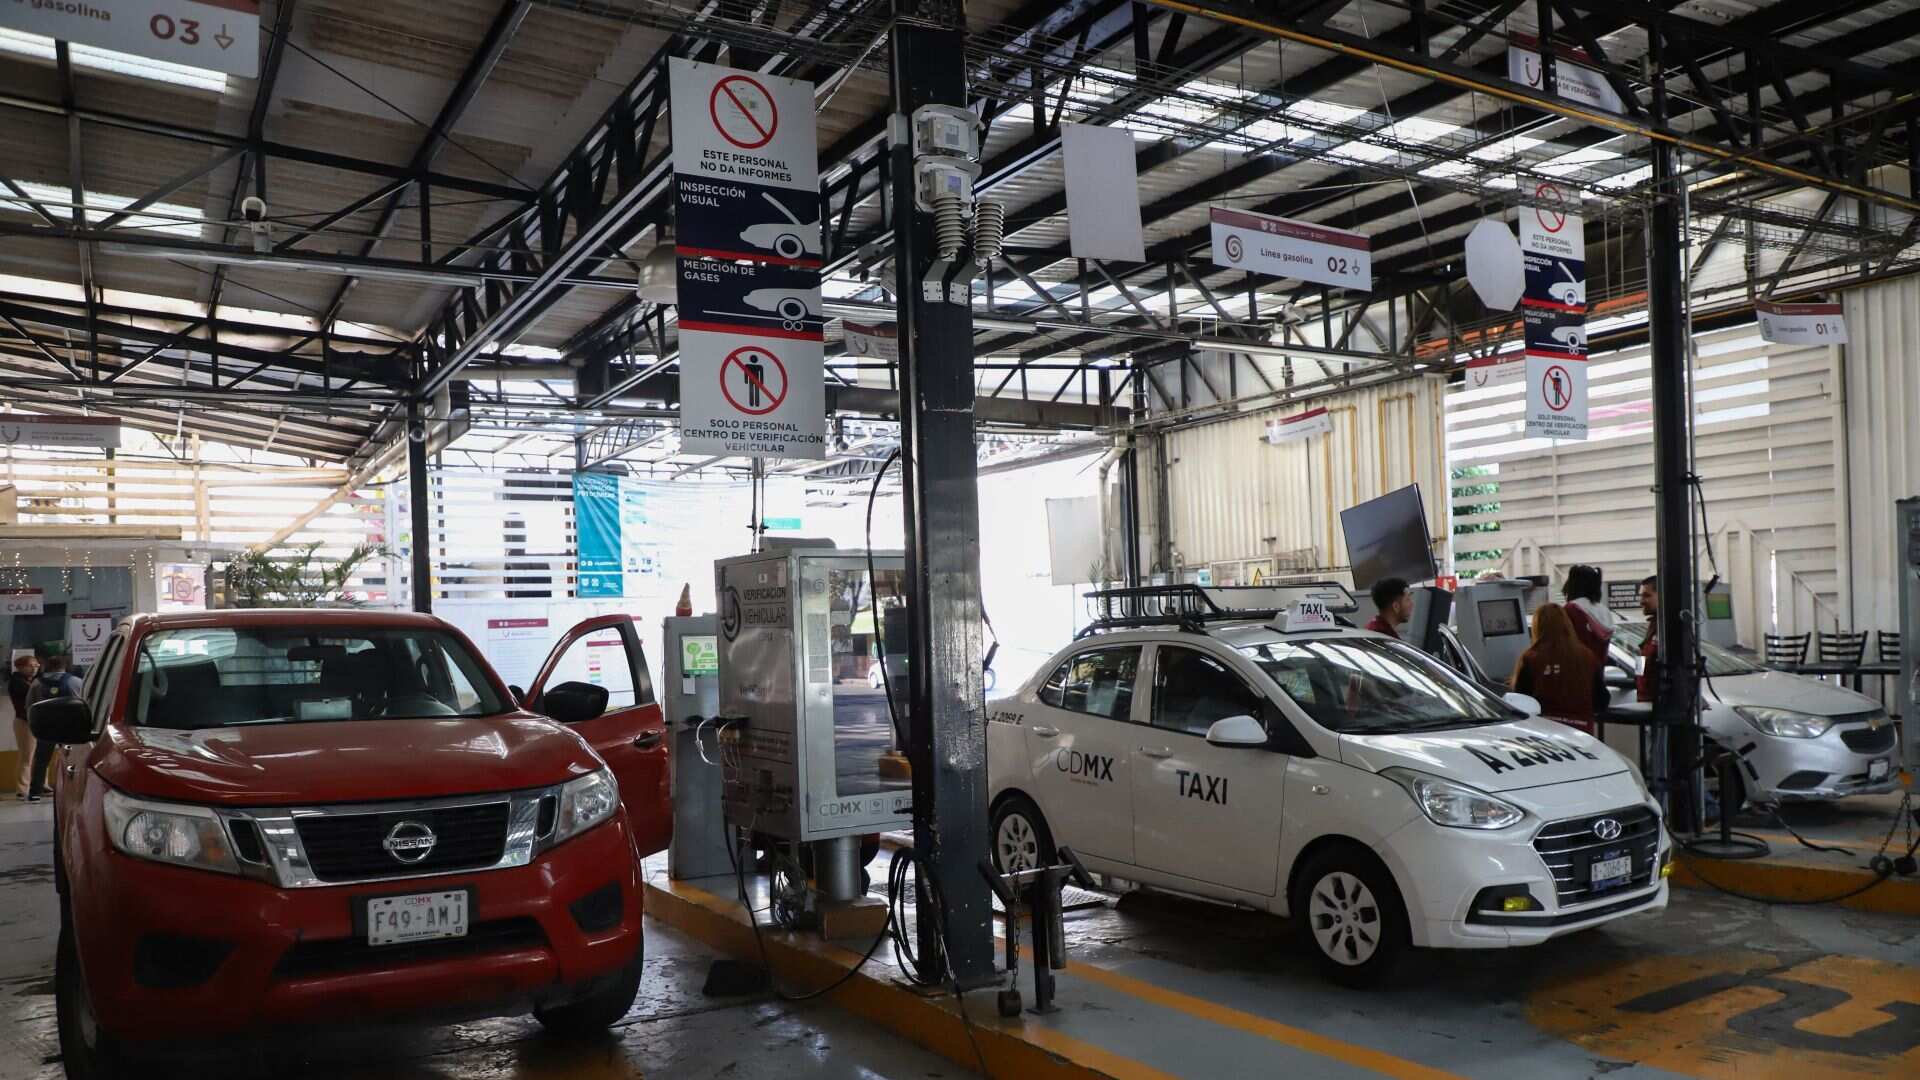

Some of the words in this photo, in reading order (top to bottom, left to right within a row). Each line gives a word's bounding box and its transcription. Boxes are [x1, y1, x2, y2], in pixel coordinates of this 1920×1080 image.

[150, 13, 200, 45] 03
[703, 149, 729, 162] ESTE
[732, 153, 789, 171] PERSONAL
[700, 160, 717, 172] NO
[719, 163, 735, 174] DA
[738, 165, 793, 182] INFORMES
[680, 180, 746, 199] INSPECCIÓN
[680, 193, 721, 208] VISUAL
[1545, 236, 1572, 247] PERSONAL
[683, 259, 738, 275] MEDICIÓN
[740, 266, 756, 276] DE
[1282, 252, 1314, 264] gasolina
[1327, 256, 1348, 275] 02
[684, 271, 720, 283] GASES
[1815, 323, 1829, 335] 01
[710, 419, 739, 429] SOLO
[742, 420, 799, 432] PERSONAL
[1551, 414, 1576, 422] PERSONAL
[684, 429, 729, 440] CENTRO
[731, 430, 746, 441] DE
[749, 430, 823, 444] VERIFICACIÓN
[725, 442, 785, 453] VEHICULAR
[8, 604, 37, 612] CAJA
[1300, 603, 1322, 615] TAXI
[1056, 748, 1114, 782] CDMX
[1462, 744, 1515, 775] A
[1176, 768, 1228, 805] TAXI
[819, 801, 862, 817] CDMX
[389, 837, 434, 848] NISSAN
